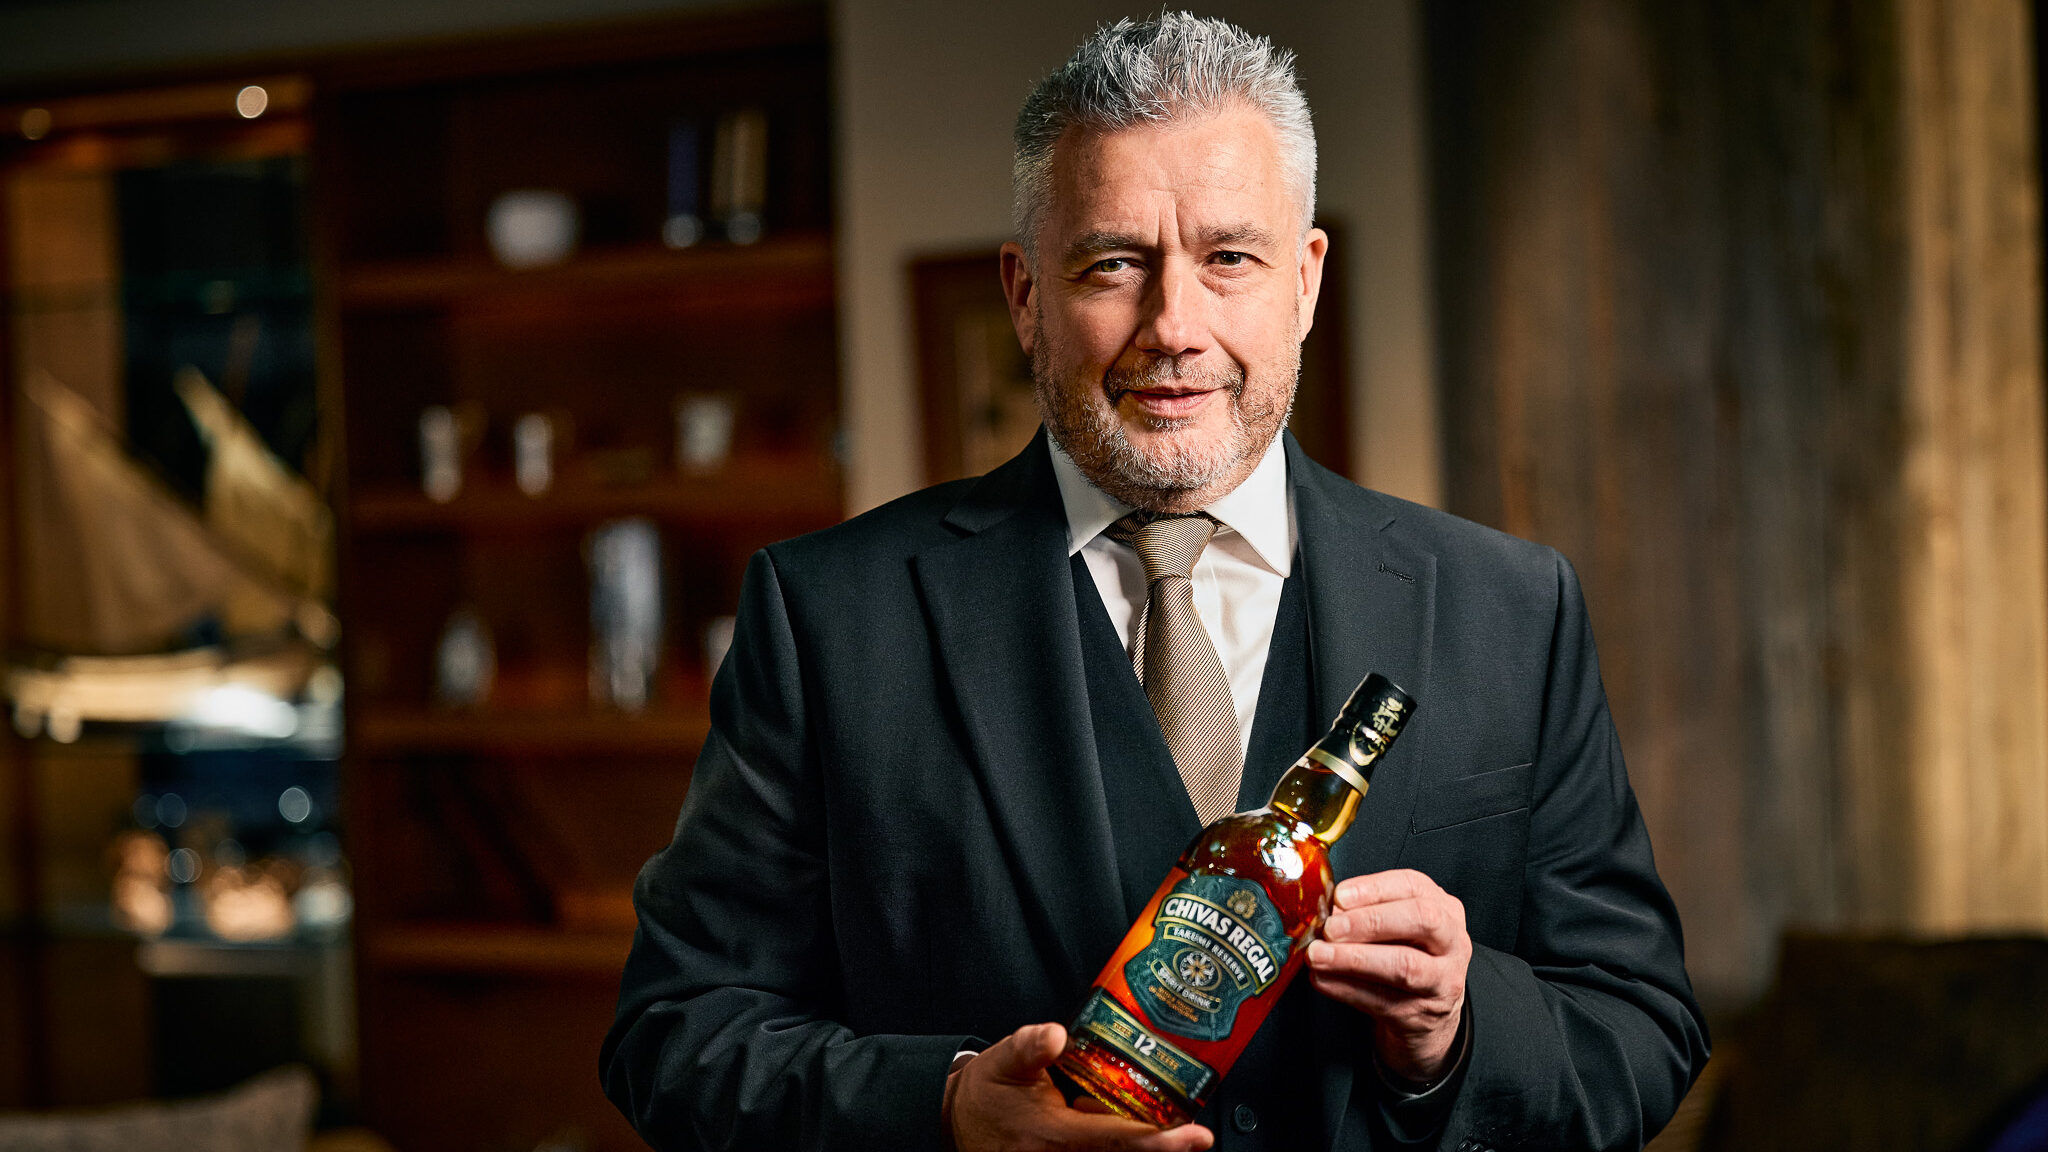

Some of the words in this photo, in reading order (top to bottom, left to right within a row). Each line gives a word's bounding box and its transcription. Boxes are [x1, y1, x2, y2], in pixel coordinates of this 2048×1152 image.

[1165, 898, 1232, 936] CHIVAS
[1227, 925, 1274, 984] REGAL
[1173, 926, 1212, 949] TAKUMI
[1211, 944, 1246, 981] RESERVE
[1182, 988, 1211, 1009] DRINK
[1134, 1033, 1157, 1057] 12
